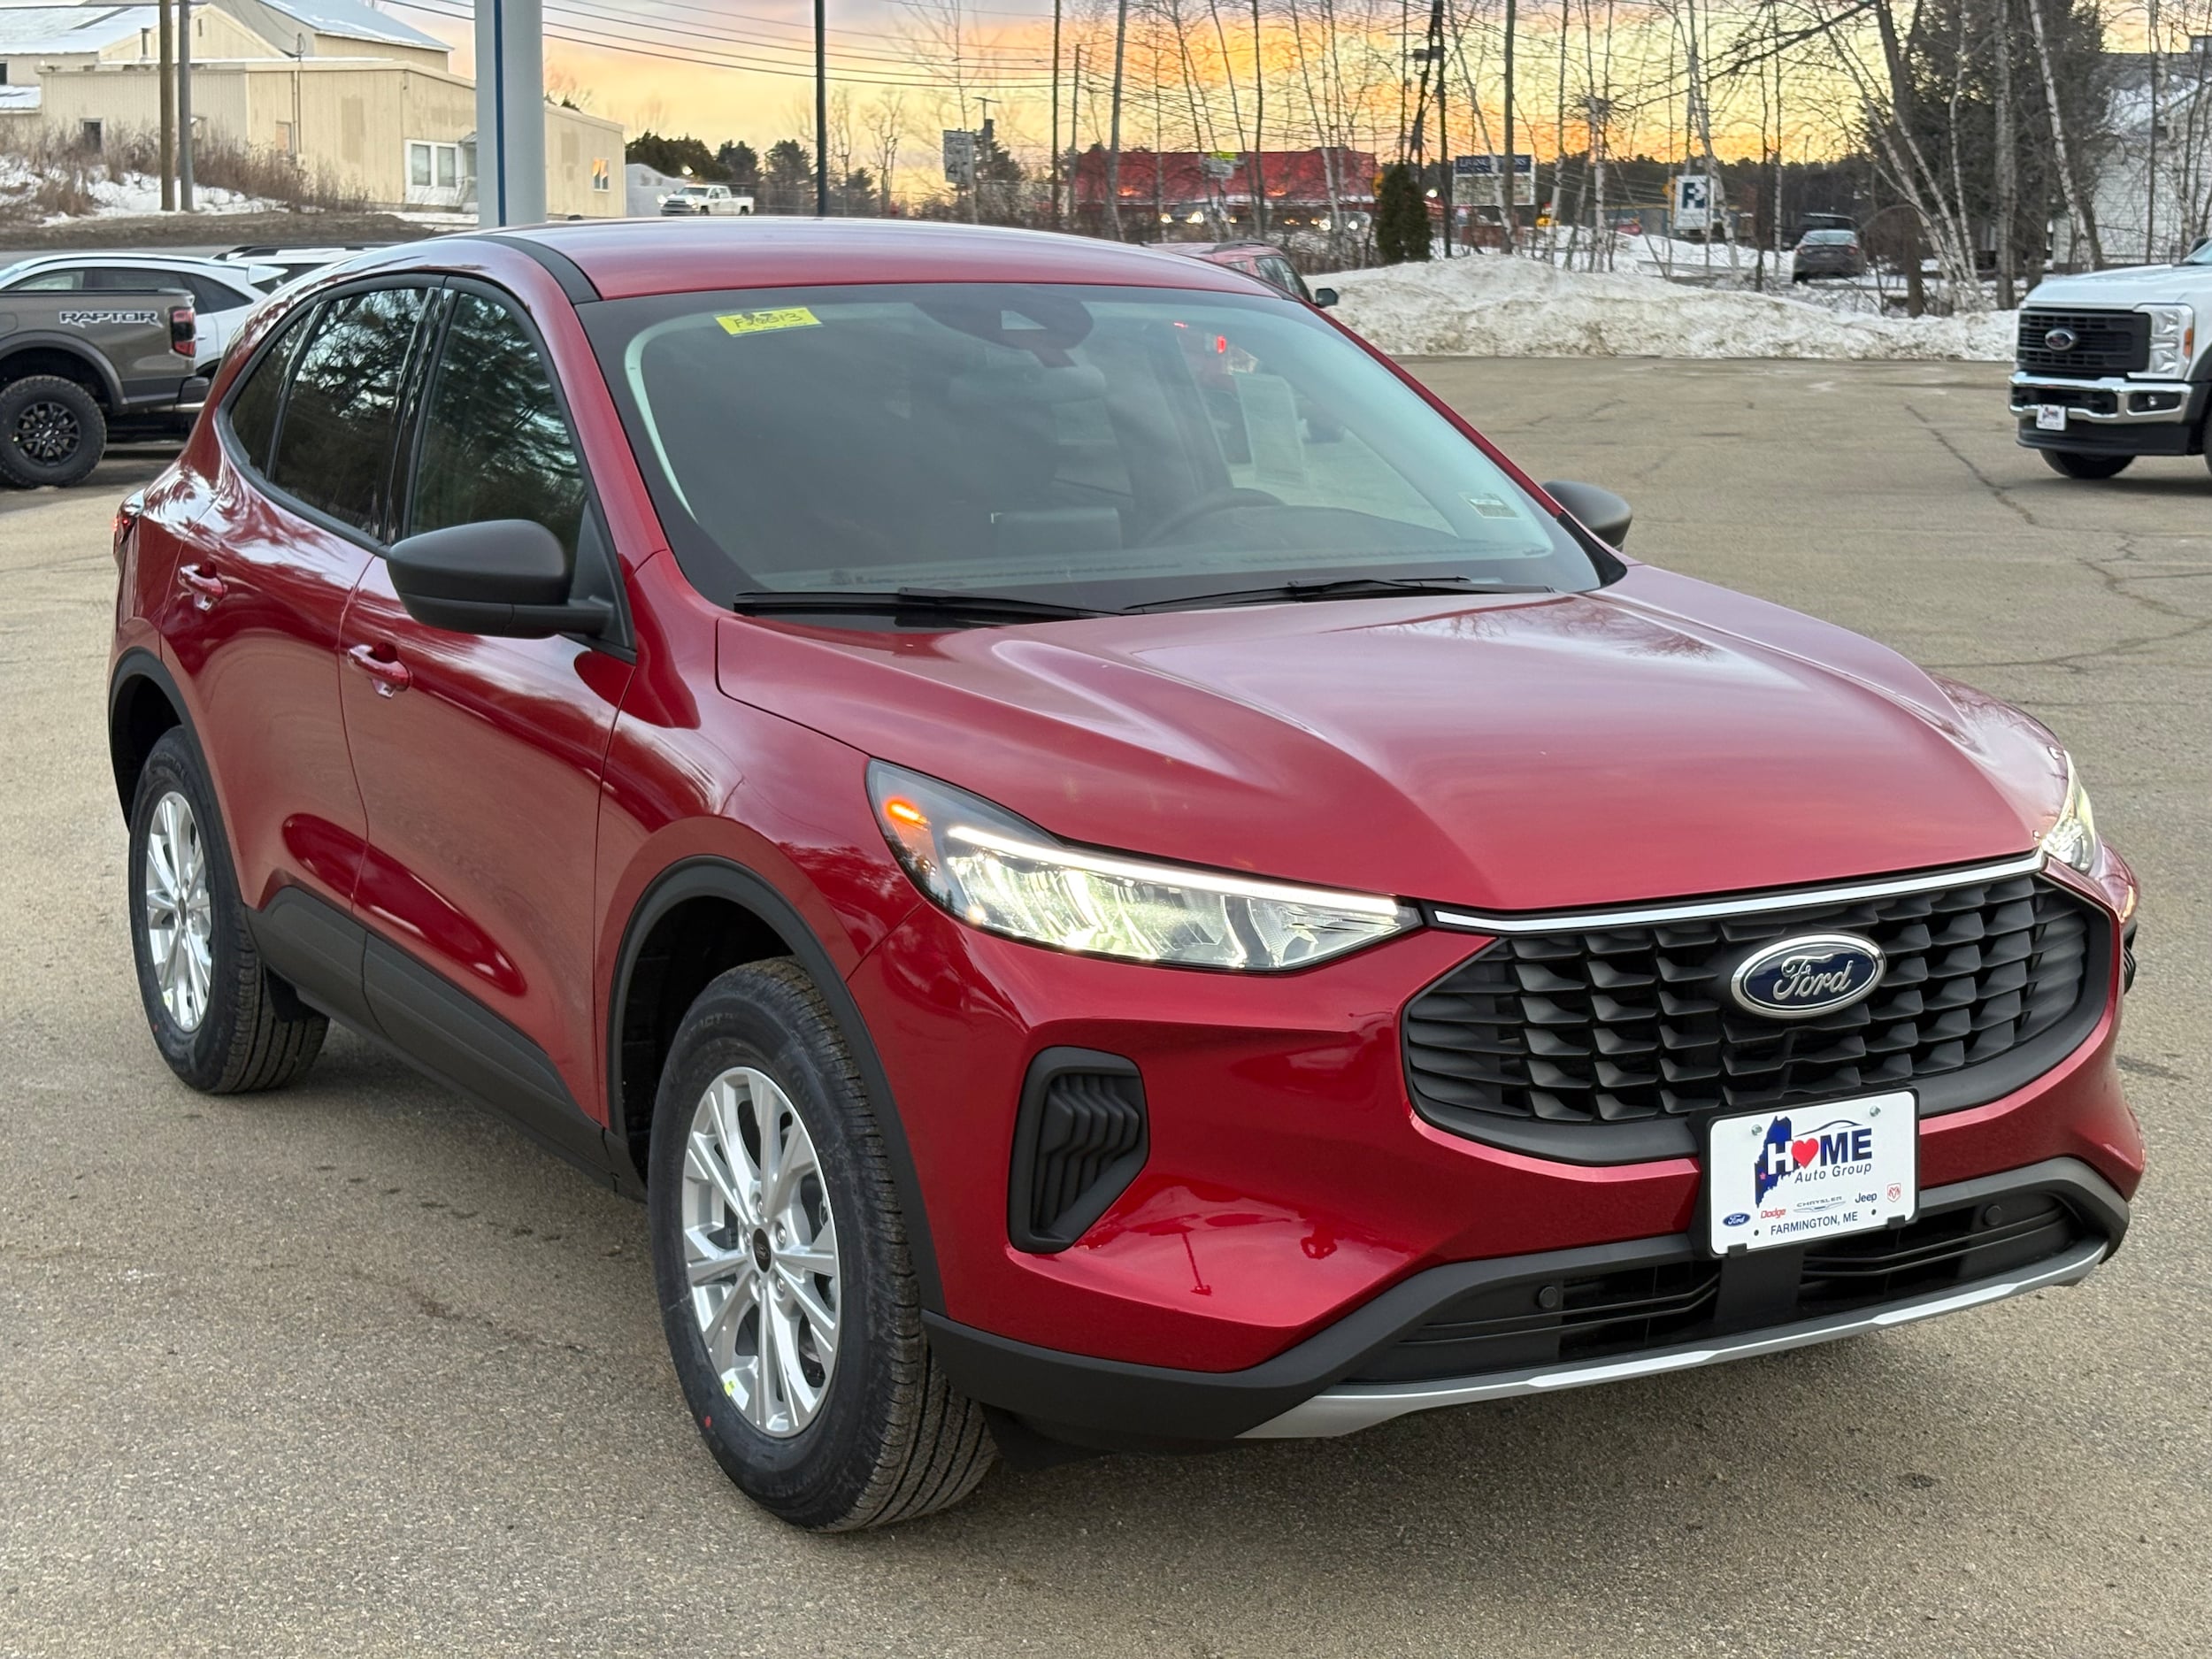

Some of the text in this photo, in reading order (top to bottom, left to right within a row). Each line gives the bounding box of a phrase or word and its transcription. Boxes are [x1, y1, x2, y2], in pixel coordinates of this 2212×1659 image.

[60, 311, 164, 328] RAPTOR
[1772, 954, 1854, 1001] Ford
[1794, 1162, 1872, 1184] Auto Group
[1796, 1195, 1843, 1207] CHRYSLER
[1855, 1192, 1878, 1204] Jeep
[1760, 1208, 1786, 1219] Dodge
[1770, 1211, 1858, 1236] FARMINGTON, ME
